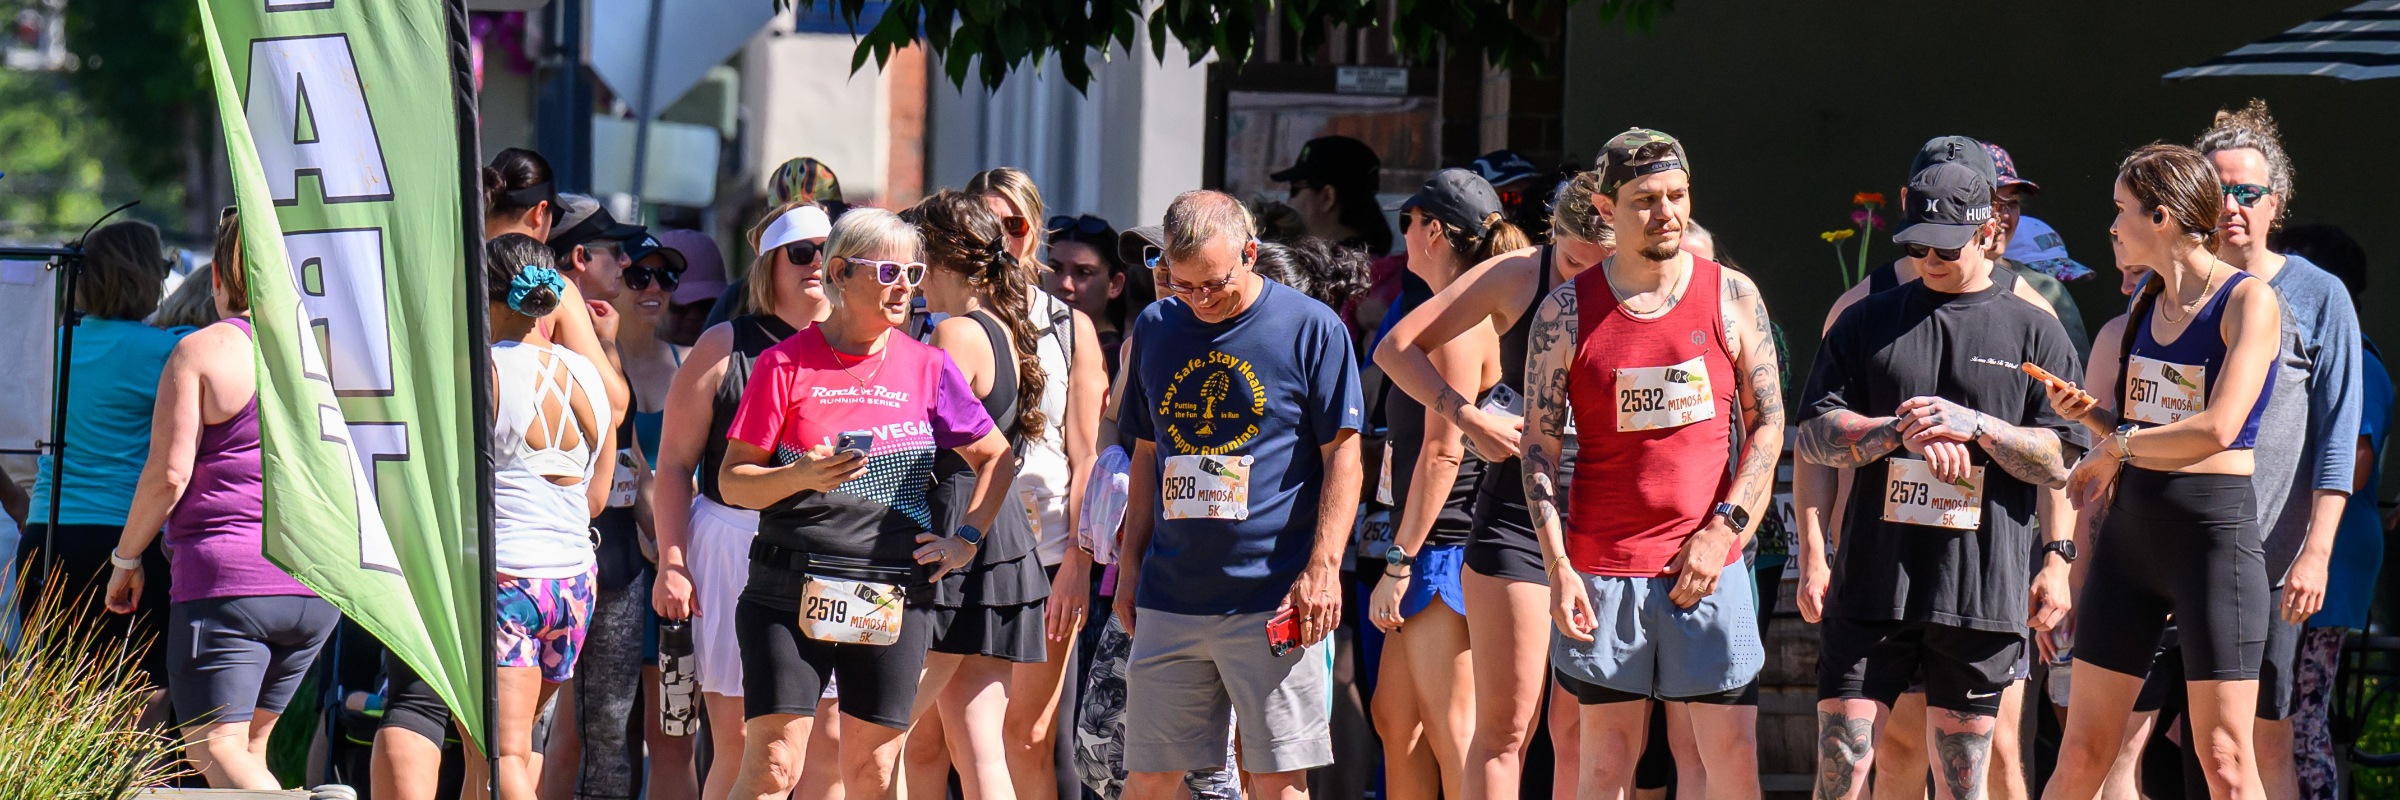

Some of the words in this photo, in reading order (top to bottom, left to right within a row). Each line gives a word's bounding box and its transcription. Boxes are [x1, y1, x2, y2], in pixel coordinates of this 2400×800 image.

[1159, 383, 1178, 415] Stay
[1174, 358, 1206, 383] Safe,
[1208, 350, 1239, 369] Stay
[1238, 360, 1267, 416] Healthy
[2130, 377, 2158, 404] 2577
[811, 386, 859, 397] Rock
[873, 385, 909, 402] Roll
[1620, 388, 1665, 413] 2532
[820, 397, 865, 405] RUNNING
[867, 398, 901, 408] SERIES
[1174, 402, 1197, 411] Putting
[1667, 394, 1703, 411] MIMOSA
[2161, 396, 2193, 411] MIMOSA
[1220, 411, 1227, 419] in
[1228, 411, 1239, 419] Run
[1681, 411, 1693, 423] 5K
[1167, 424, 1199, 455] Happy
[1201, 423, 1259, 456] Running
[1165, 476, 1196, 500] 2528
[1198, 490, 1234, 502] MIMOSA
[1890, 480, 1929, 505] 2573
[1208, 505, 1220, 516] 5K
[1931, 498, 1968, 512] MIMOSA
[1942, 514, 1955, 525] 5K
[1363, 521, 1393, 542] 252
[806, 596, 847, 623] 2519
[850, 615, 887, 631] MIMOSA
[859, 632, 873, 642] 5K
